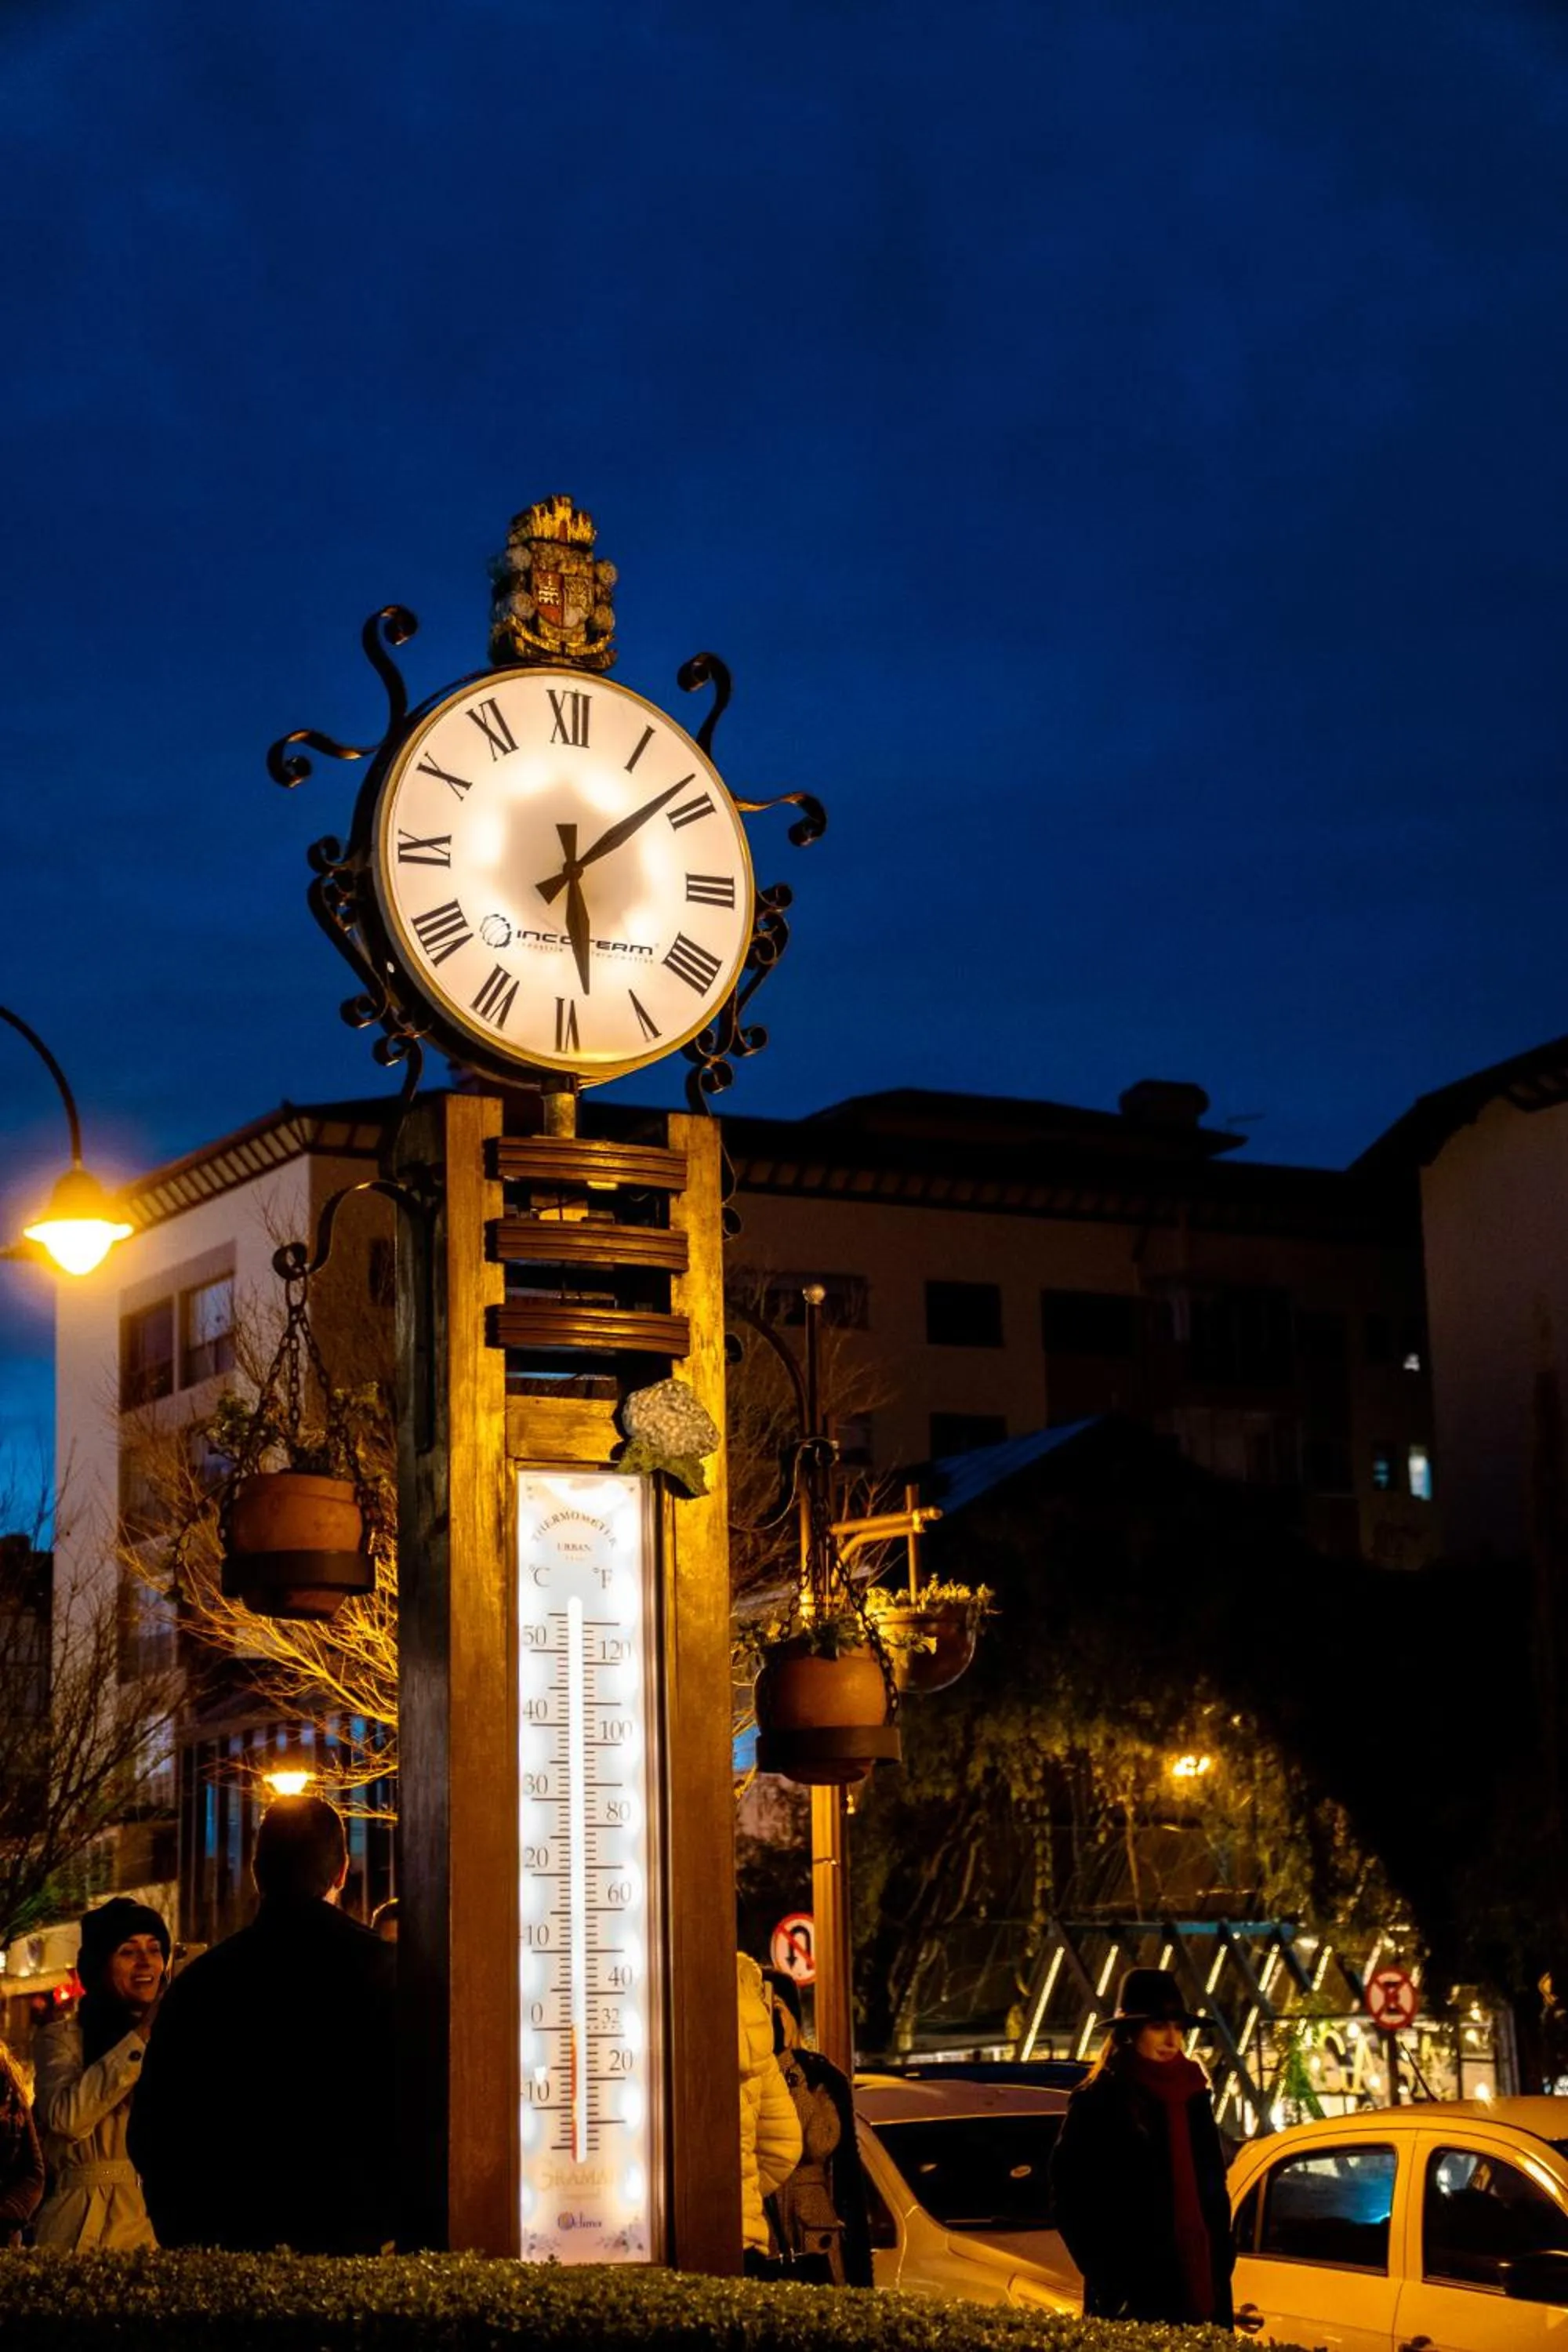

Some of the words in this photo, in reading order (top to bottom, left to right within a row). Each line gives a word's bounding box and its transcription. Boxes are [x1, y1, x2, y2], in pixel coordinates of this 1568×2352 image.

[466, 698, 519, 761] XI
[546, 690, 592, 749] XII
[624, 726, 655, 773] I
[416, 752, 472, 801] X
[666, 791, 717, 831] II
[397, 829, 452, 868] IX
[685, 873, 735, 910] III
[412, 898, 474, 967] VIII
[517, 930, 653, 956] INCOERM
[662, 931, 722, 997] IIII
[470, 964, 519, 1030] VII
[555, 997, 580, 1053] VI
[629, 989, 662, 1043] V
[524, 1625, 547, 1646] 50
[599, 1639, 631, 1661] 120
[523, 1699, 548, 1720] 40
[599, 1720, 633, 1740] 100
[524, 1773, 548, 1795] 30
[606, 1800, 631, 1821] 80
[524, 1846, 549, 1869] 20
[607, 1882, 632, 1903] 60
[524, 1924, 550, 1946] 10
[608, 1965, 633, 1987] 40
[531, 2002, 543, 2024] 0
[602, 2008, 620, 2024] 32
[608, 2049, 633, 2071] 20
